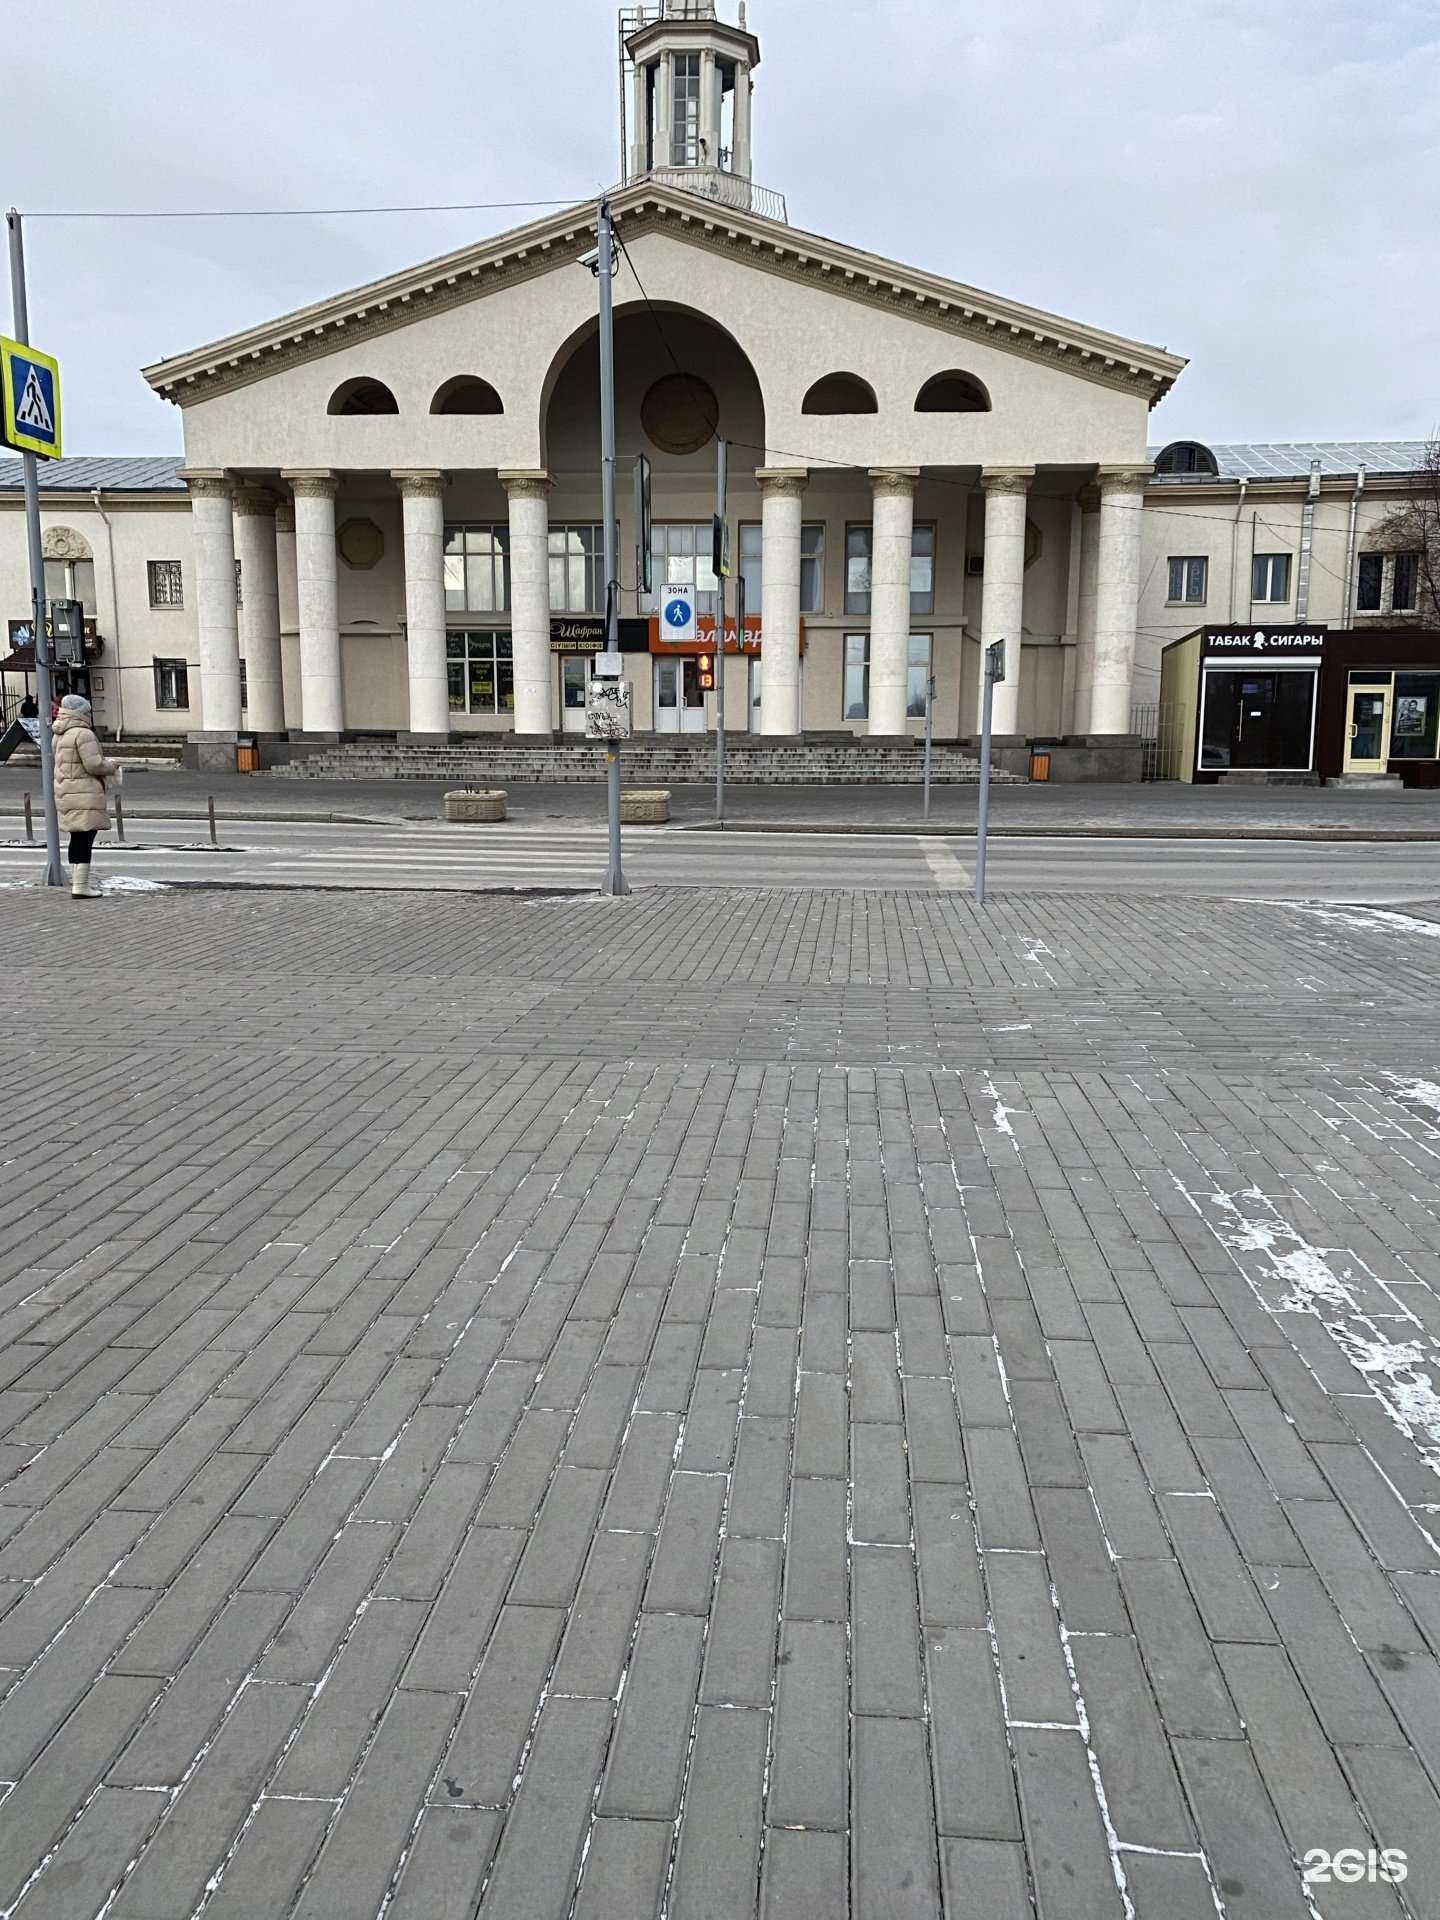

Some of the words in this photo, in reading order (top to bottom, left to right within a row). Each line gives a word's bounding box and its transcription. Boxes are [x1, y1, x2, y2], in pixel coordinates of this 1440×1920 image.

[668, 586, 689, 594] ЗОНА
[1208, 635, 1251, 646] ТАБАК
[1270, 635, 1323, 646] СИГАРЫ
[701, 674, 713, 688] 13
